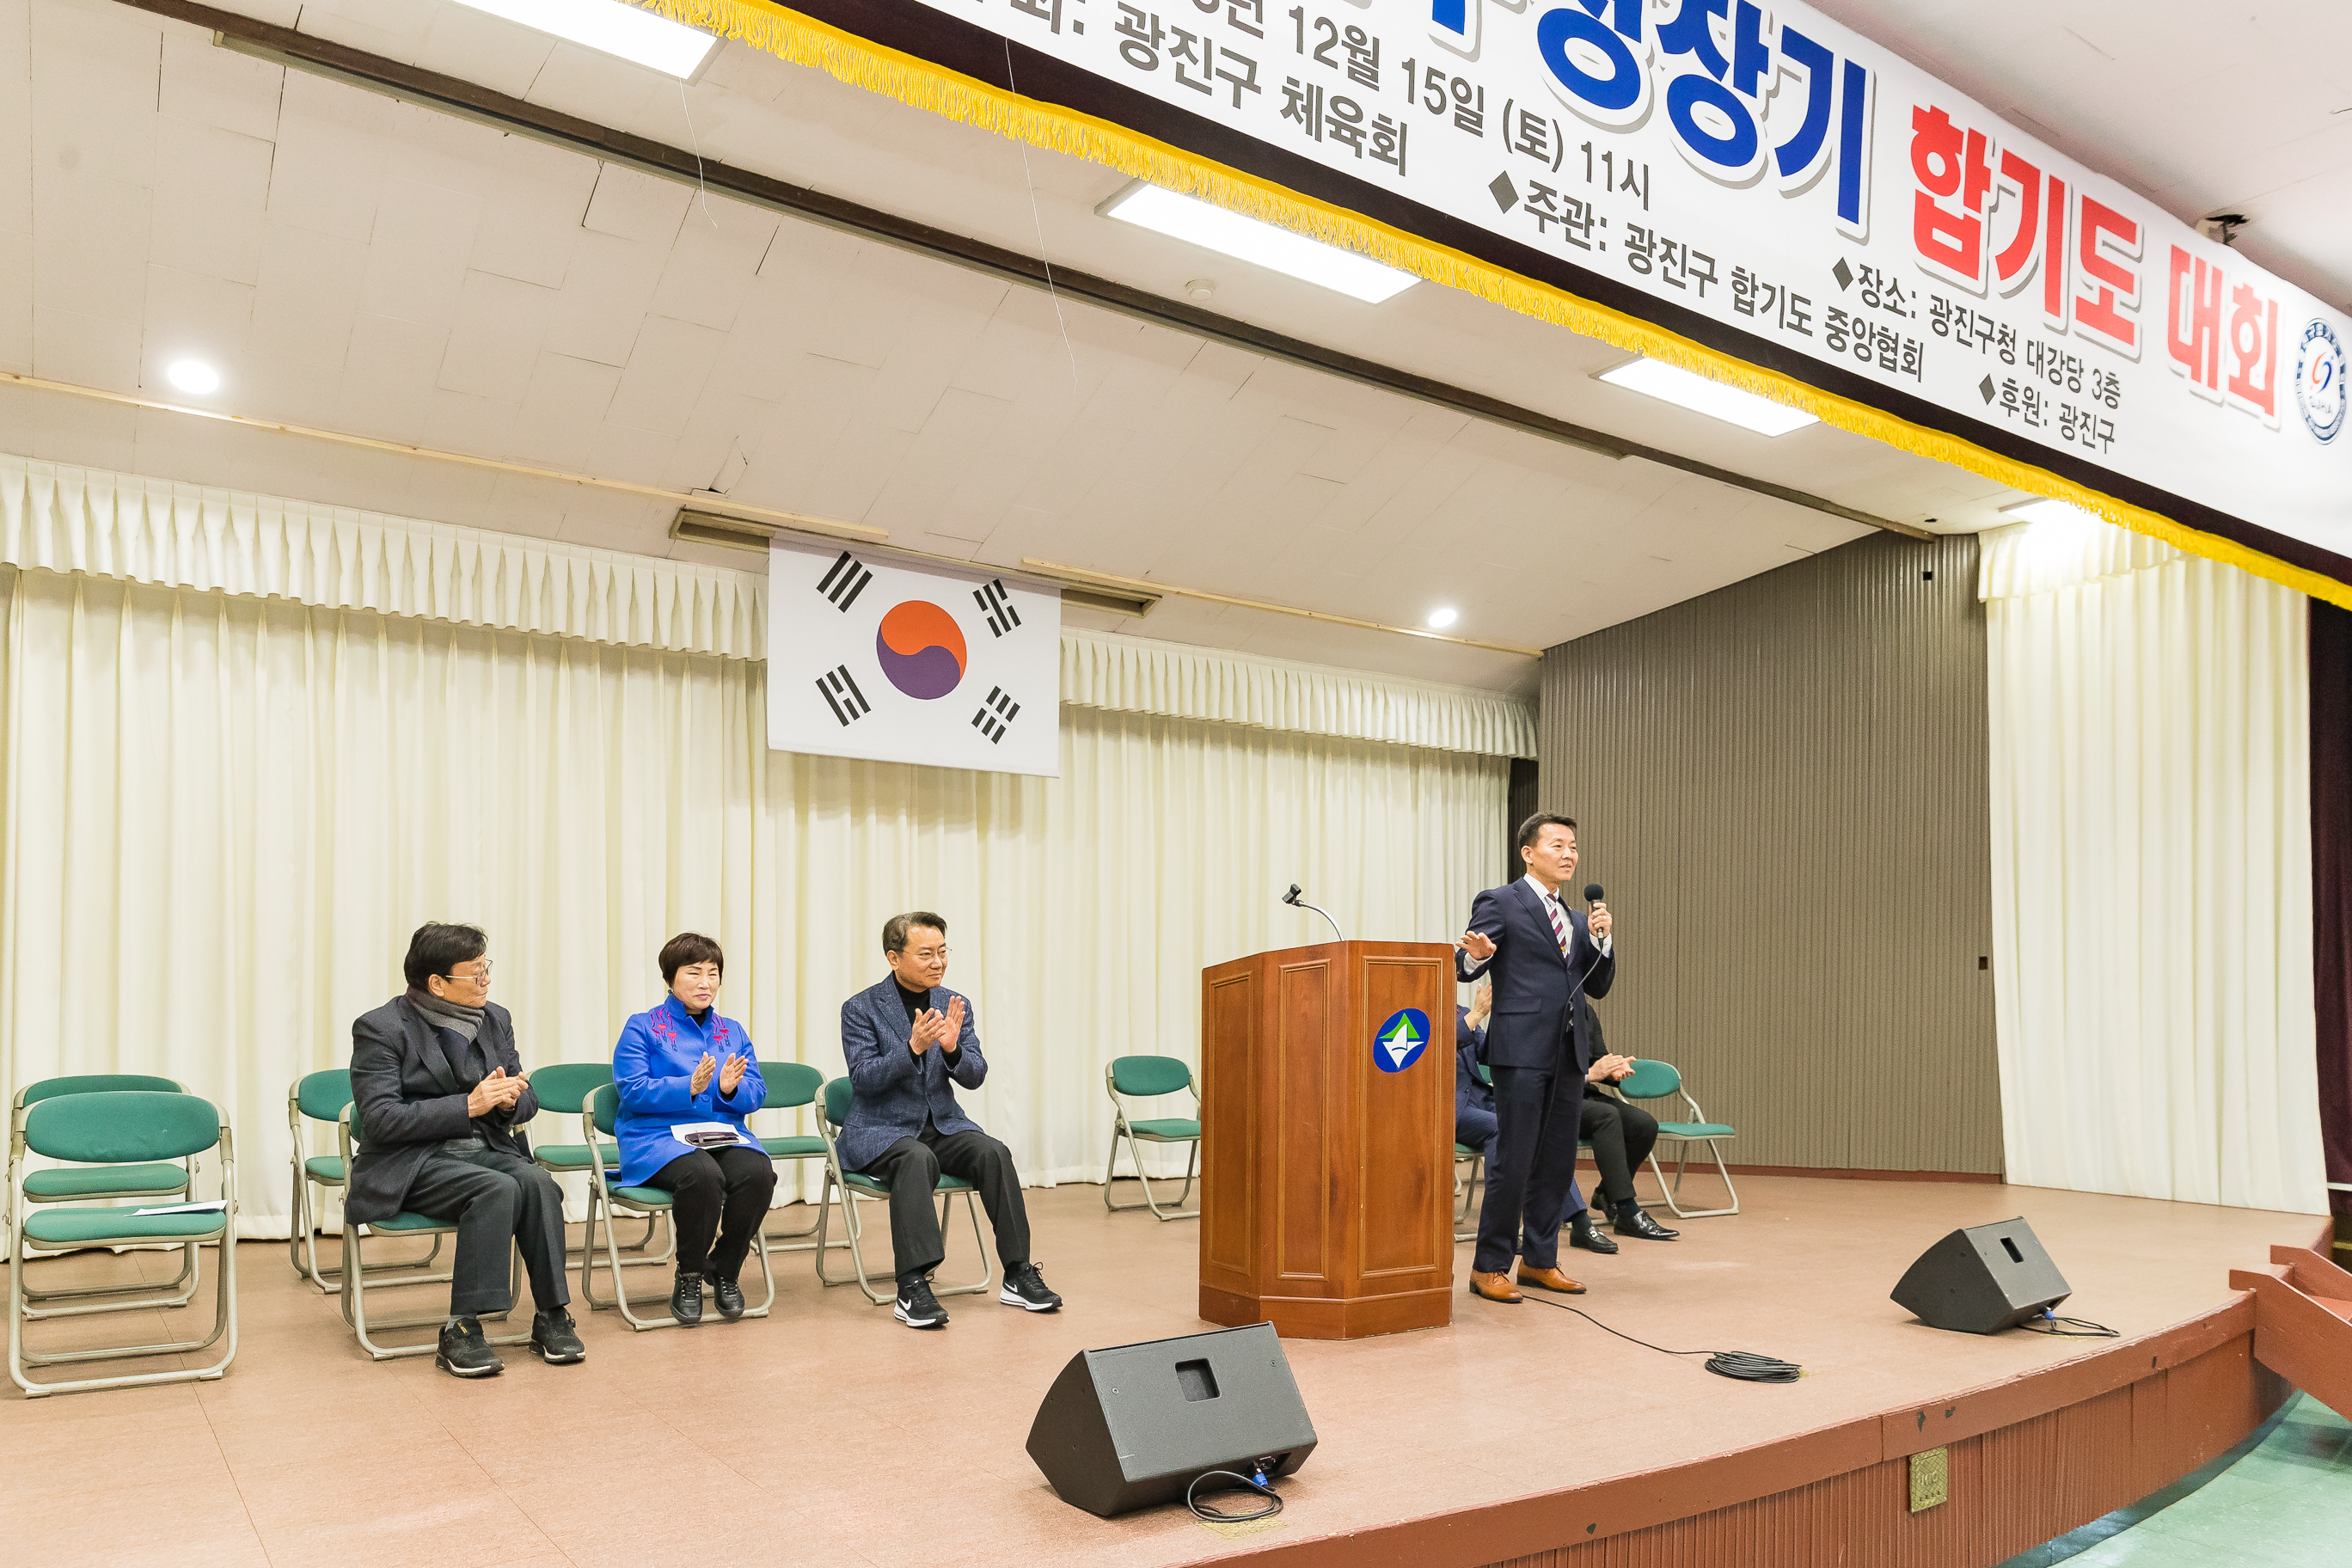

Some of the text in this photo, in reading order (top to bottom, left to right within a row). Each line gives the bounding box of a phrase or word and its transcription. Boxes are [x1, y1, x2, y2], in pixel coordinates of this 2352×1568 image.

[1114, 2, 1408, 176] 광진구 체육회
[1289, 5, 1380, 92] 12월
[1401, 57, 1485, 138] 15일
[1502, 97, 1564, 173] (토)
[1580, 140, 1650, 211] 11시
[1524, 179, 1924, 383] 주관: 광진구 합기도 중앙협회
[1858, 263, 2121, 410] 장소: 광진구청 대강당 3층
[1910, 103, 2141, 346] 합기도
[2167, 243, 2280, 418] 대회
[1999, 377, 2116, 455] 후원: 광진구
